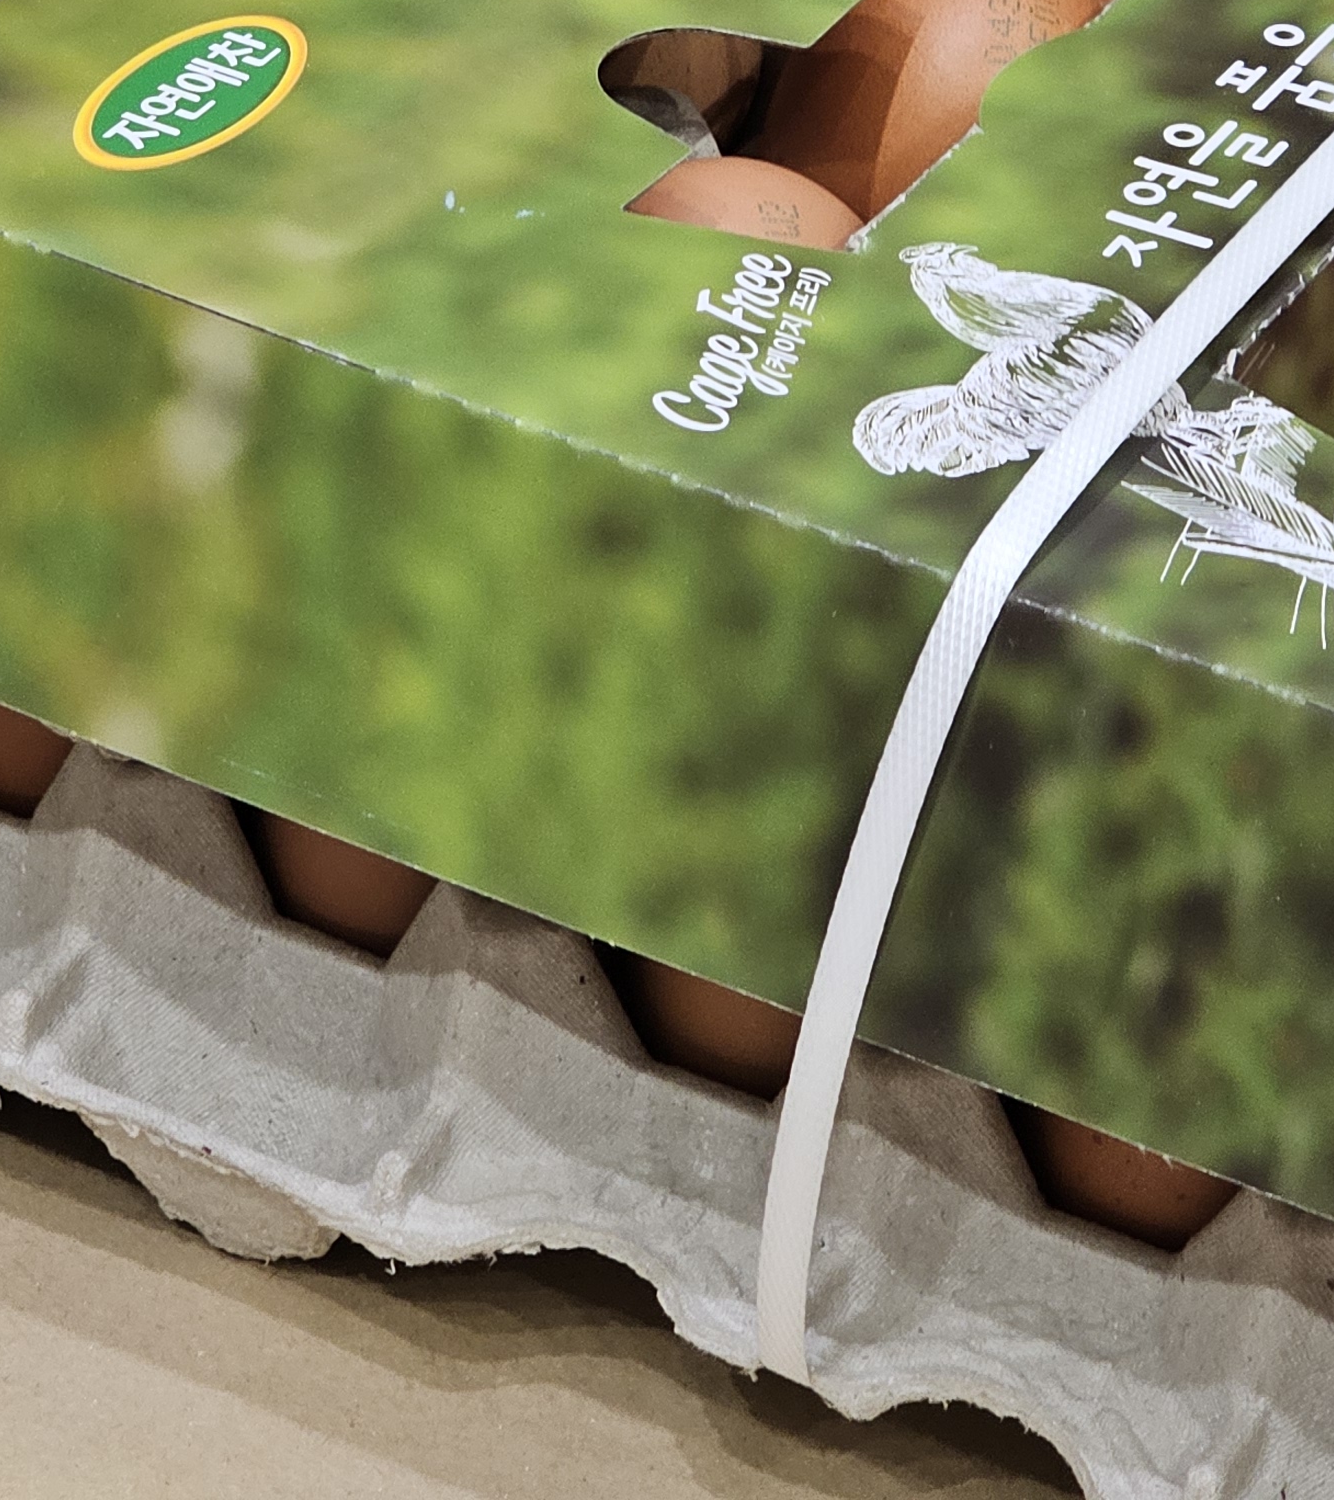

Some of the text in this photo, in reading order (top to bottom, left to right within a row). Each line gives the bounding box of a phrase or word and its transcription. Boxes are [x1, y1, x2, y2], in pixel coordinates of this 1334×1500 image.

[101, 30, 282, 150] 자연애찬
[1100, 118, 1290, 270] 자연을
[695, 252, 793, 335] Free
[651, 333, 790, 433] Cage
[760, 310, 813, 380] (케이지
